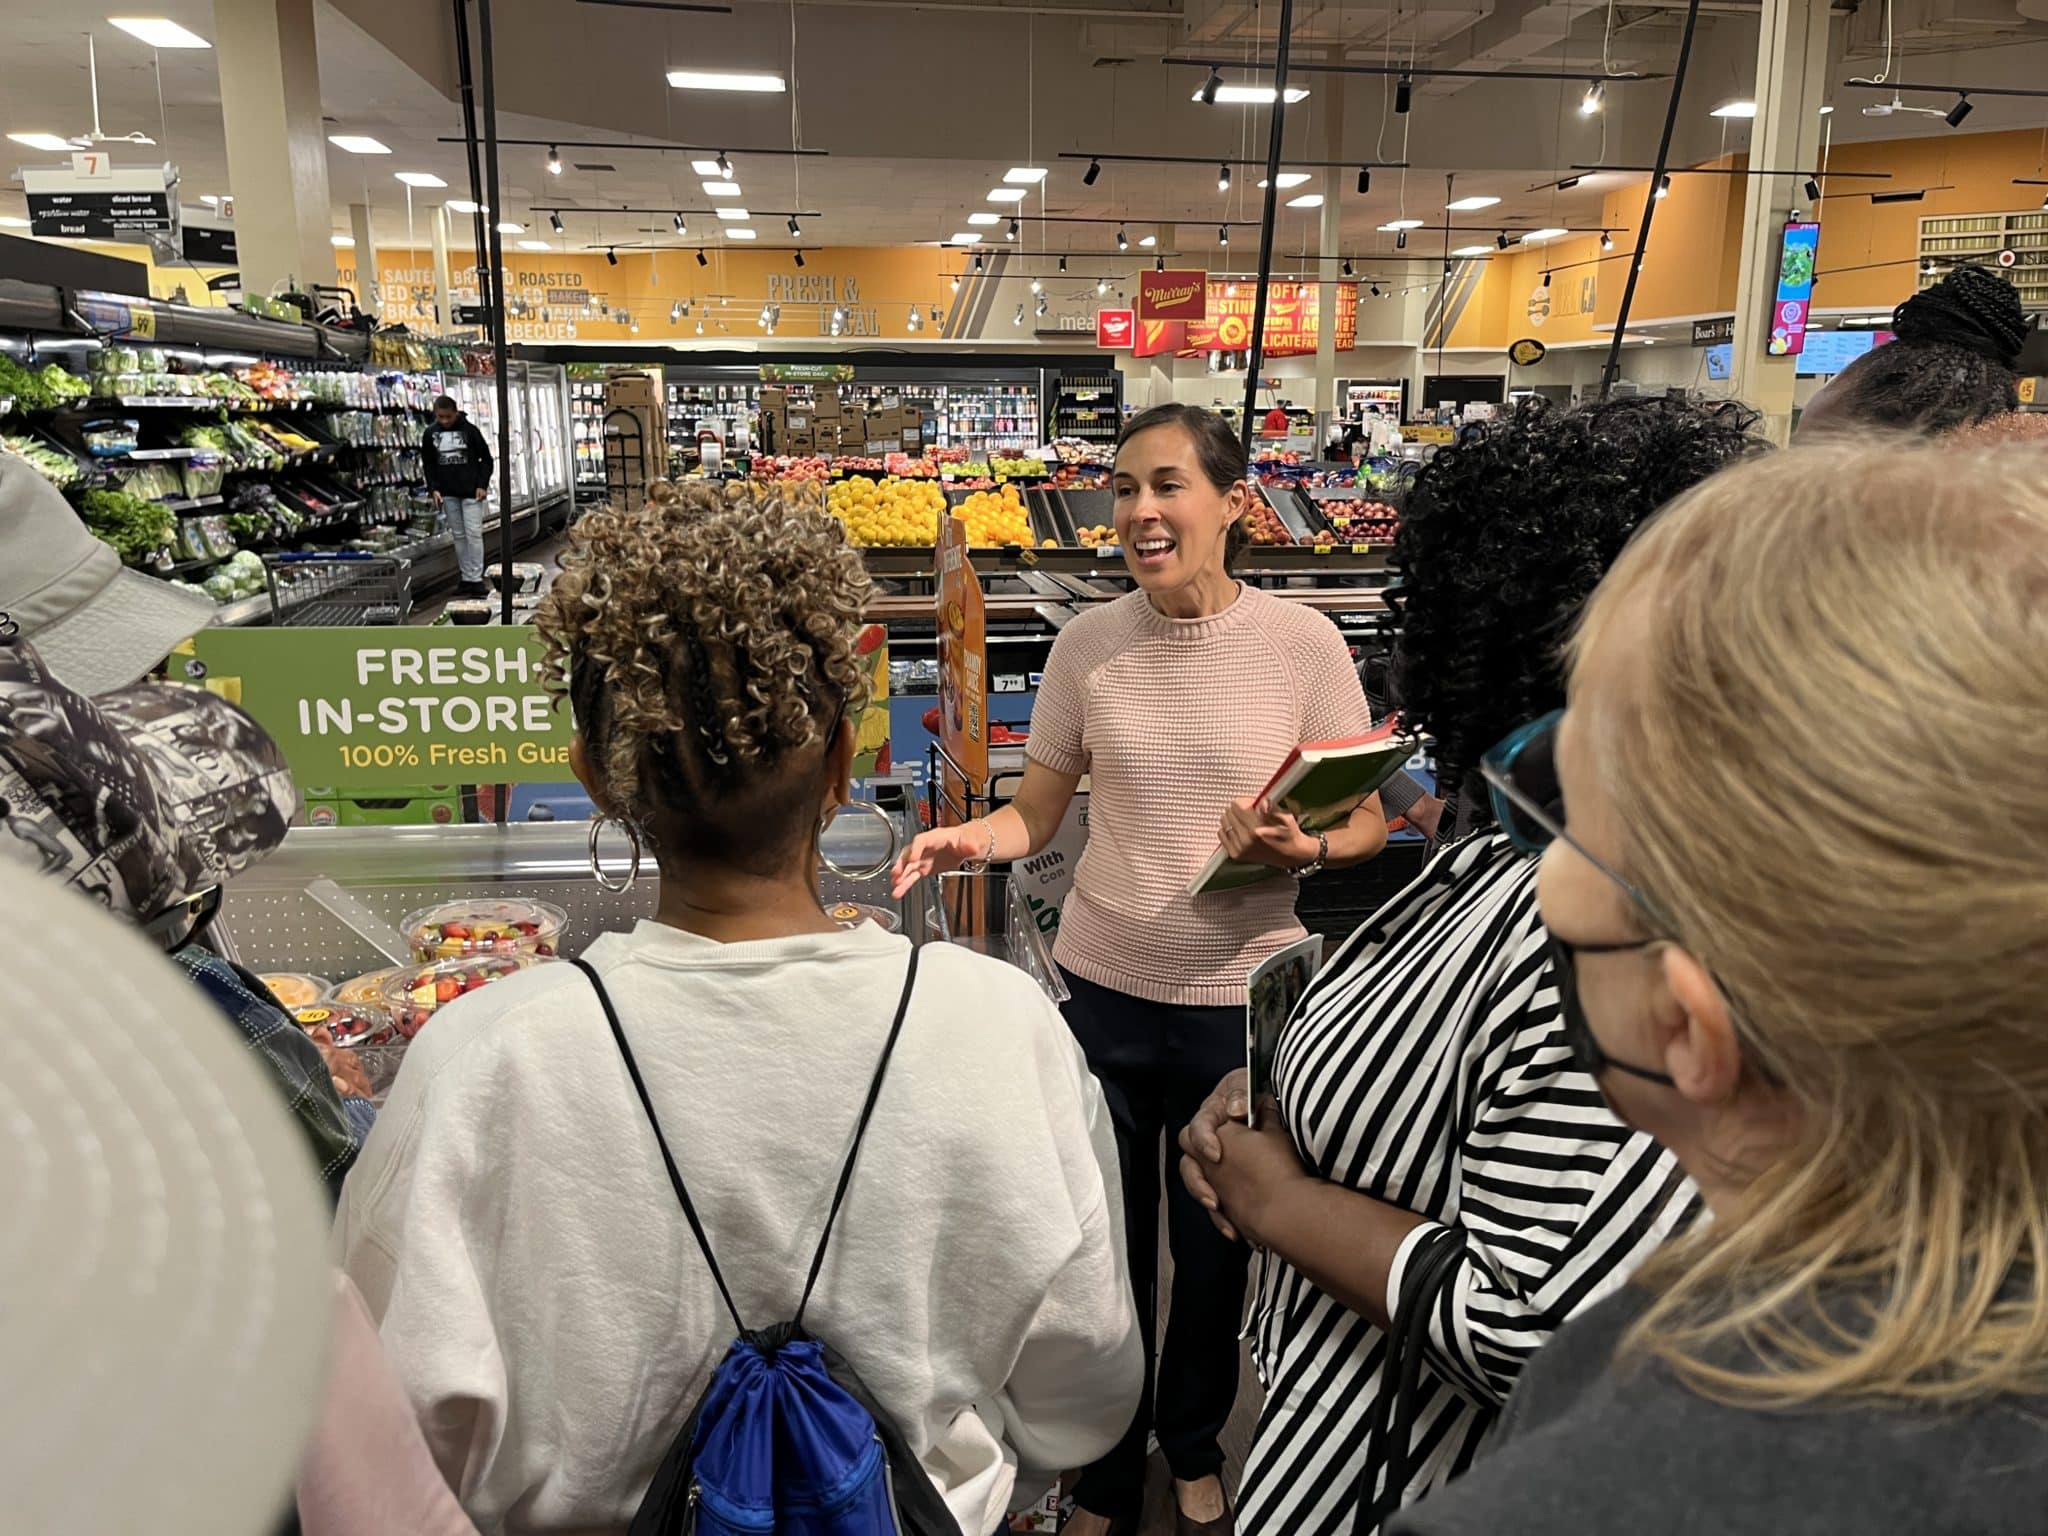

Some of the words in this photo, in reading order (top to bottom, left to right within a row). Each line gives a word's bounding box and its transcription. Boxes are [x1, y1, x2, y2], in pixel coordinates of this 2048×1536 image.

[83, 156, 97, 176] 7
[61, 224, 85, 233] bread
[384, 270, 435, 283] SAUTE
[519, 273, 582, 286] ROASTED
[768, 275, 837, 304] FRESH
[844, 275, 859, 304] &
[1145, 282, 1201, 306] Murray's
[820, 308, 881, 336] LCAL
[299, 696, 552, 735] IN-STORE
[339, 744, 420, 768] 100%
[430, 742, 507, 766] Fresh
[1024, 850, 1065, 876] With
[1040, 867, 1066, 885] Con
